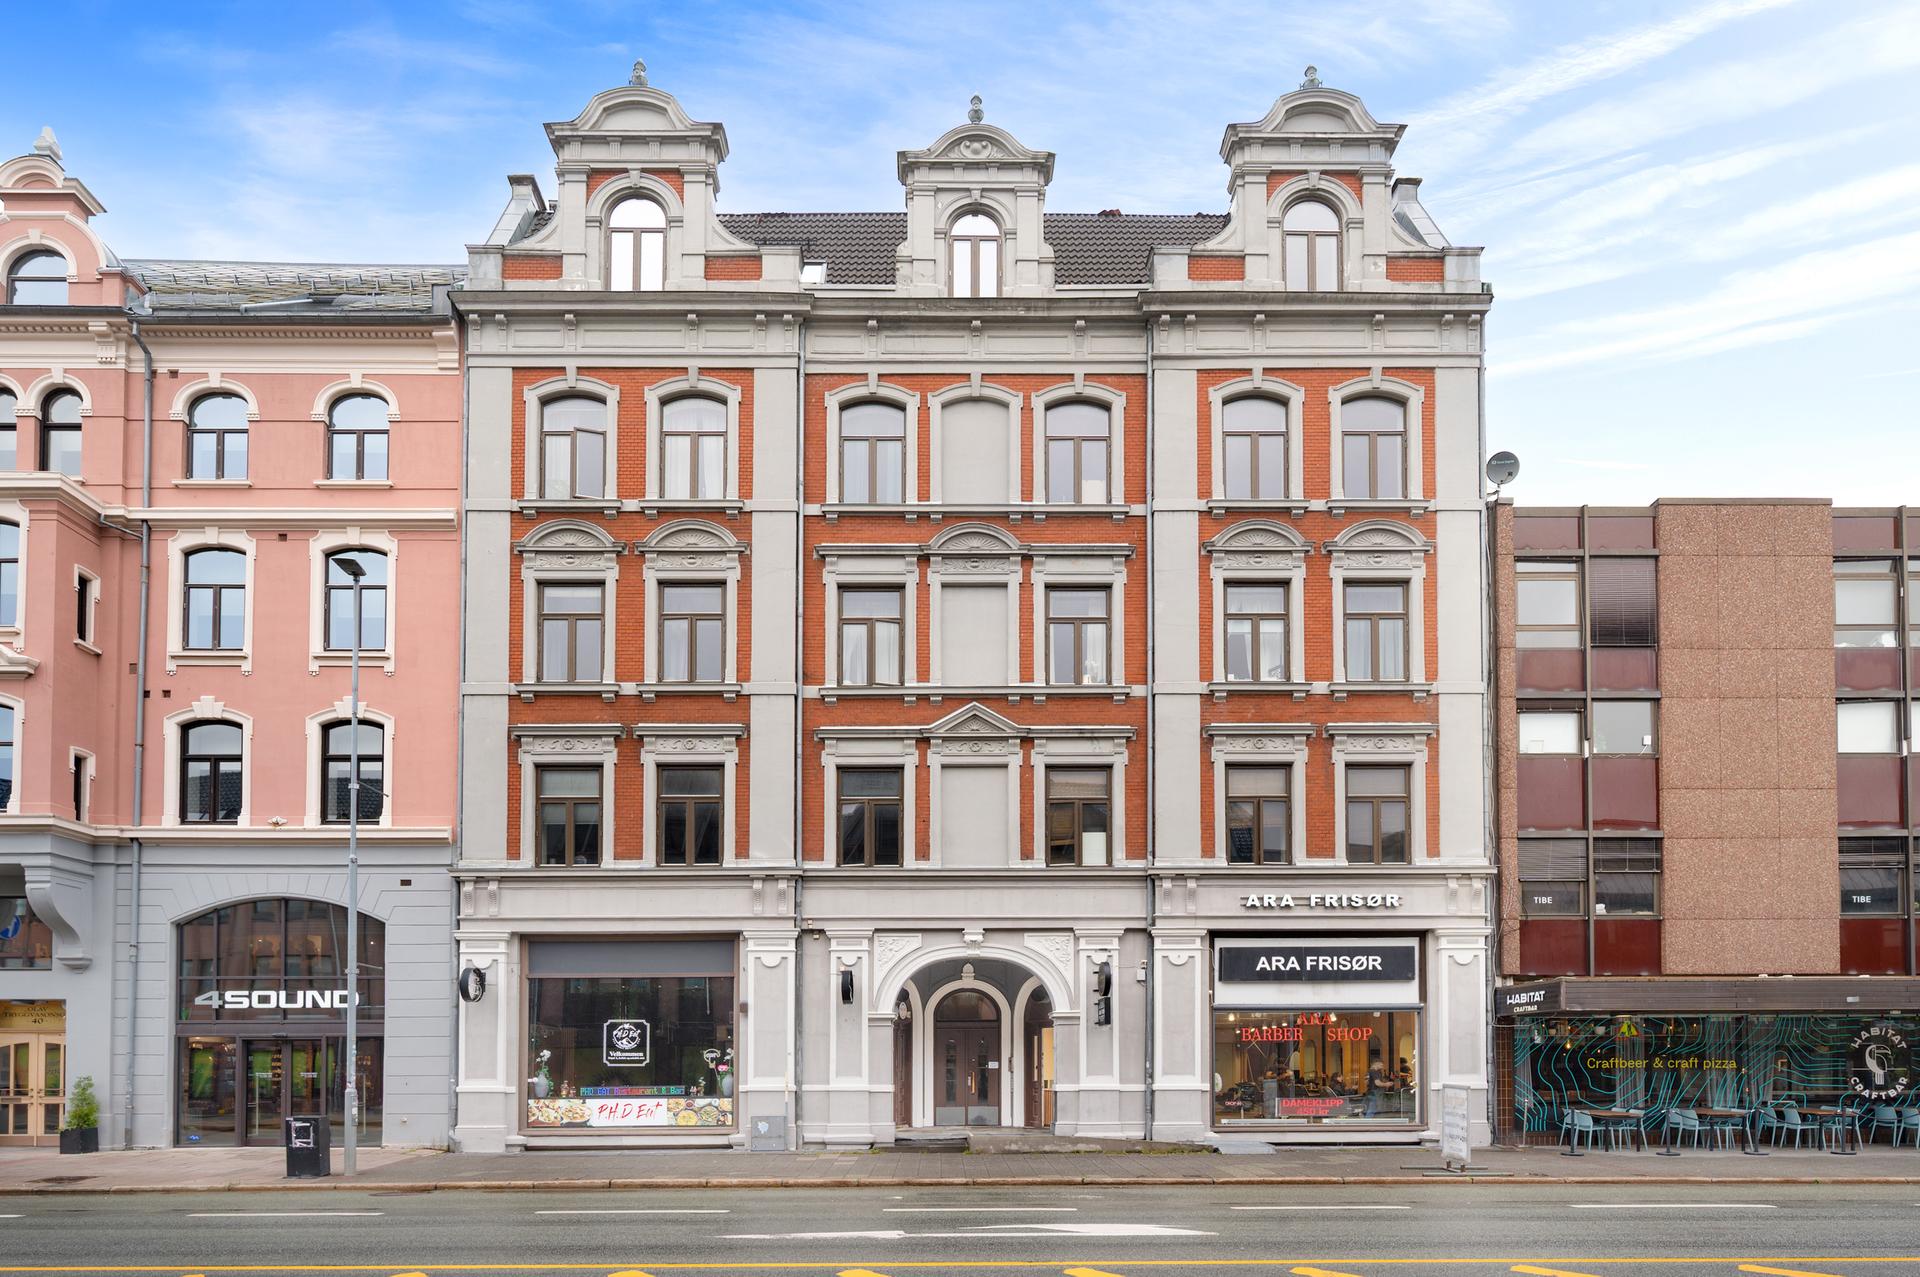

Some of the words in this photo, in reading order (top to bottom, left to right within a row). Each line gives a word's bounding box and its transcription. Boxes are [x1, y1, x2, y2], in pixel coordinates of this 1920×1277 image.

[1246, 894, 1294, 907] ARA
[1310, 894, 1399, 907] FRISØR
[1534, 896, 1553, 904] TIBE
[1852, 895, 1872, 903] TIBE
[1256, 956, 1300, 971] ARA
[1306, 955, 1382, 971] FRISØR
[194, 990, 360, 1009] 4SOUND
[1506, 991, 1545, 1005] HABITAT
[1513, 1005, 1538, 1013] CRAFTBAR
[1296, 1012, 1333, 1025] ARA
[1241, 1027, 1304, 1041] BARBER
[1327, 1027, 1373, 1041] SHOP
[1851, 1027, 1907, 1049] HABITAT
[1587, 1057, 1649, 1069] Craftbeer
[1653, 1058, 1664, 1069] &
[1667, 1057, 1698, 1069] craft
[1703, 1057, 1737, 1070] pizza
[1850, 1077, 1908, 1100] CRAFTBAR
